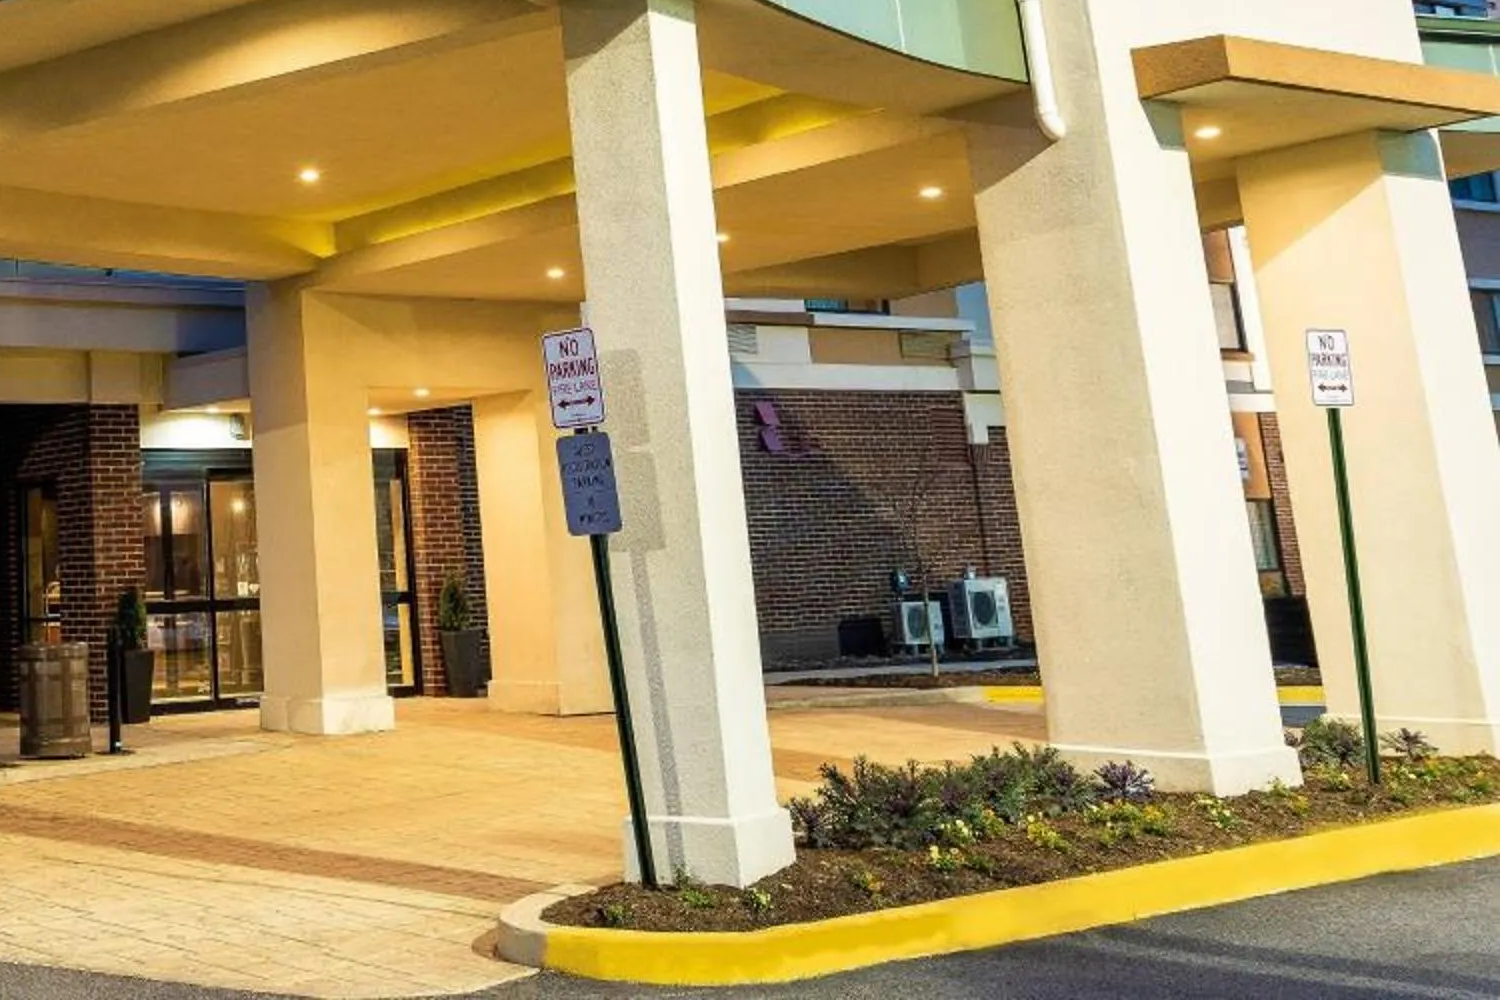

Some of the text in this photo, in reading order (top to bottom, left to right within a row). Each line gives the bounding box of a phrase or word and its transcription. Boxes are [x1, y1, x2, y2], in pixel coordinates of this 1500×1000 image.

[560, 339, 579, 357] NO
[1318, 334, 1335, 351] NO
[549, 357, 595, 378] PARKING
